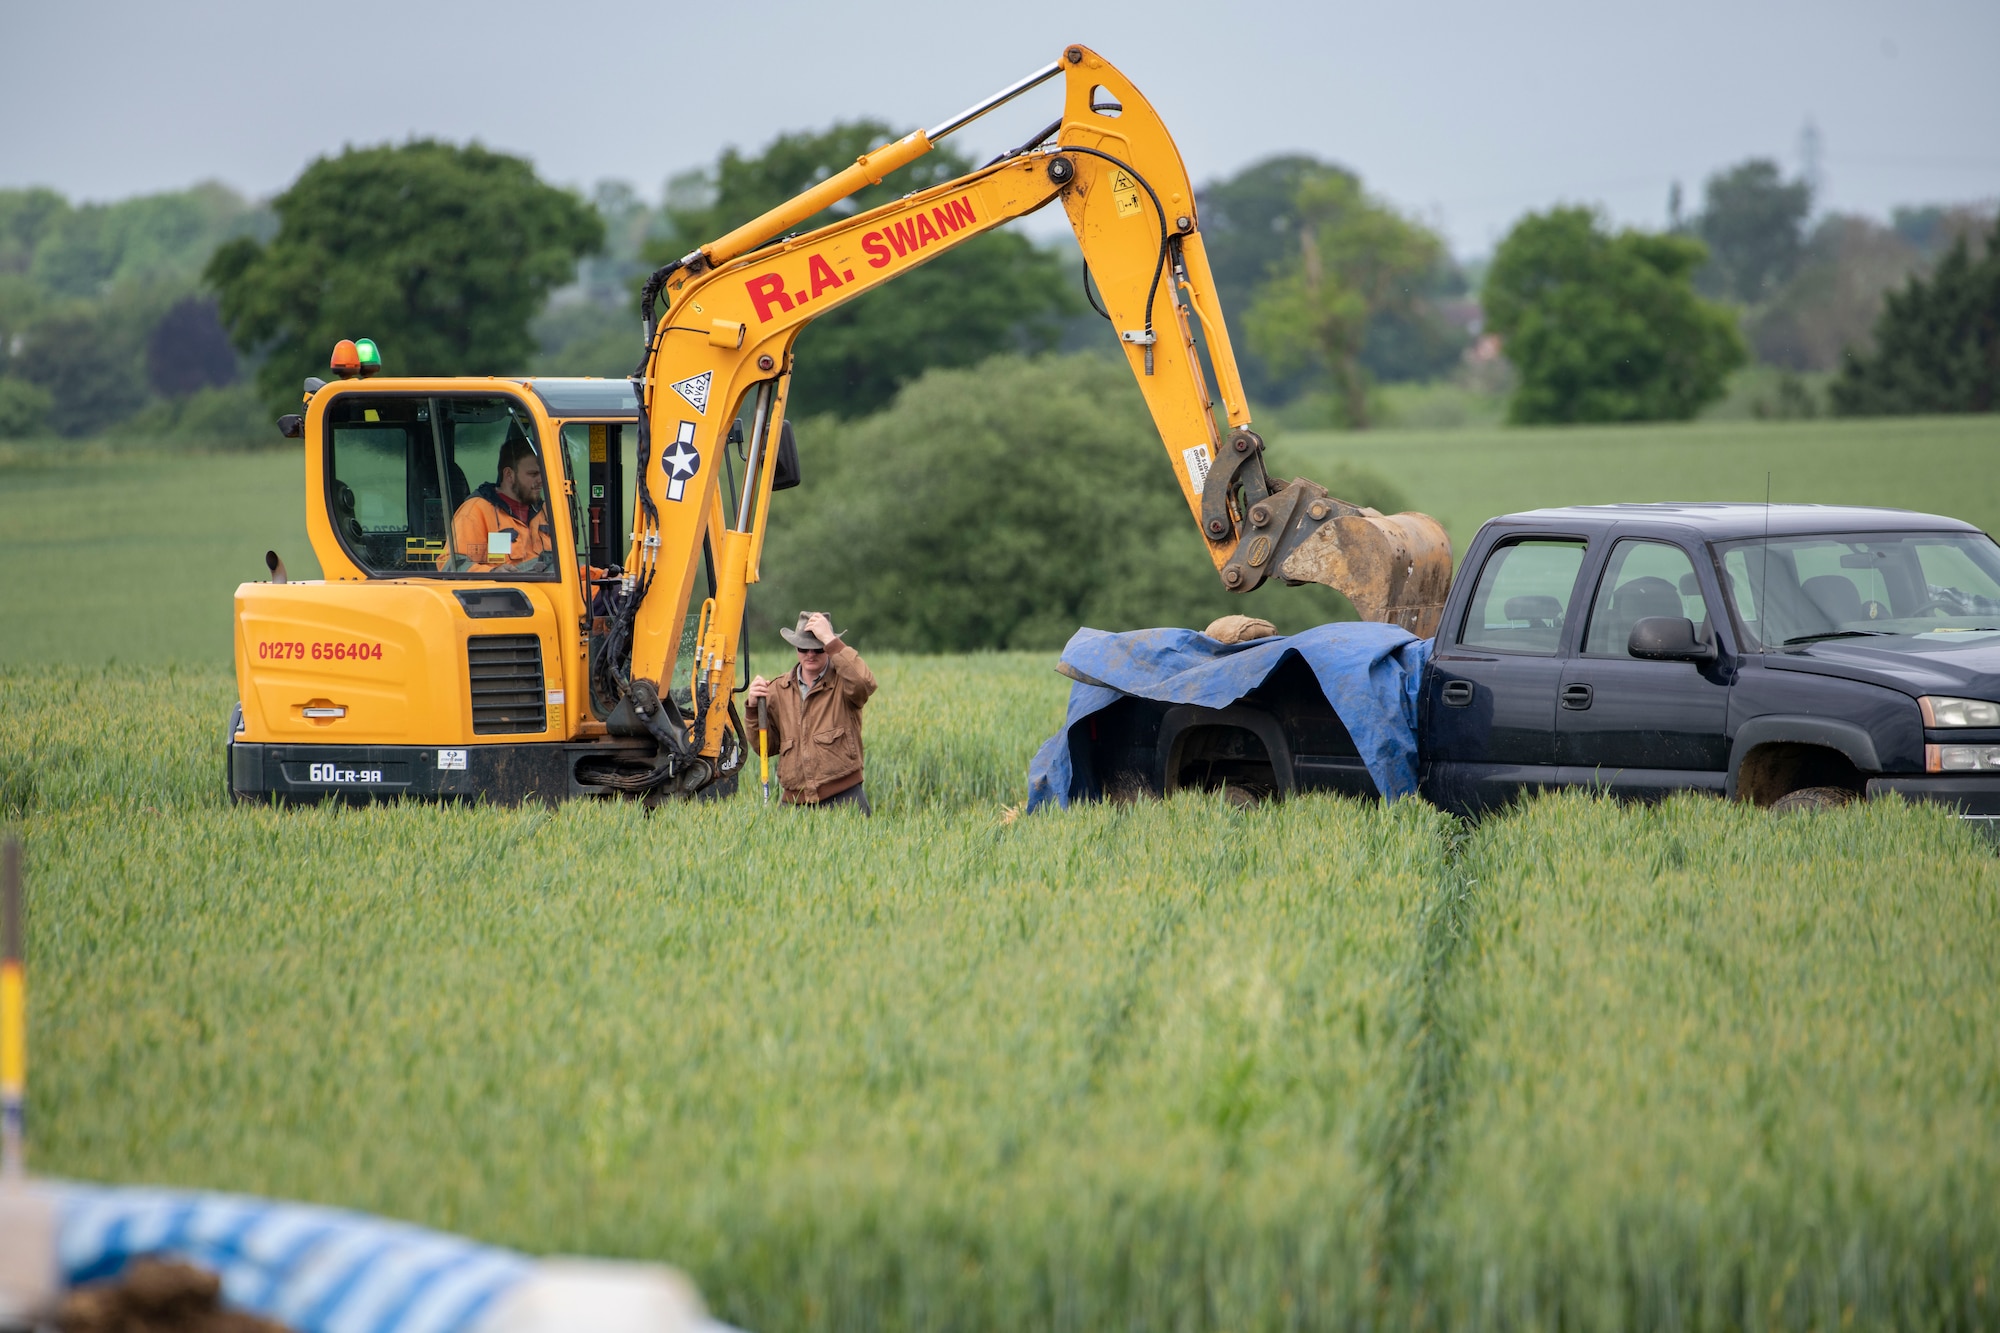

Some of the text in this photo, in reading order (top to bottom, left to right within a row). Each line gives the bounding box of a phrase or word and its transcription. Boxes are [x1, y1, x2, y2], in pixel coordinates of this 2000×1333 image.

[745, 195, 977, 324] R.A. SWANN
[684, 383, 694, 395] 97
[1193, 449, 1204, 472] COUPLER
[259, 641, 383, 660] 01279 656404
[309, 763, 382, 782] 60CR-9A
